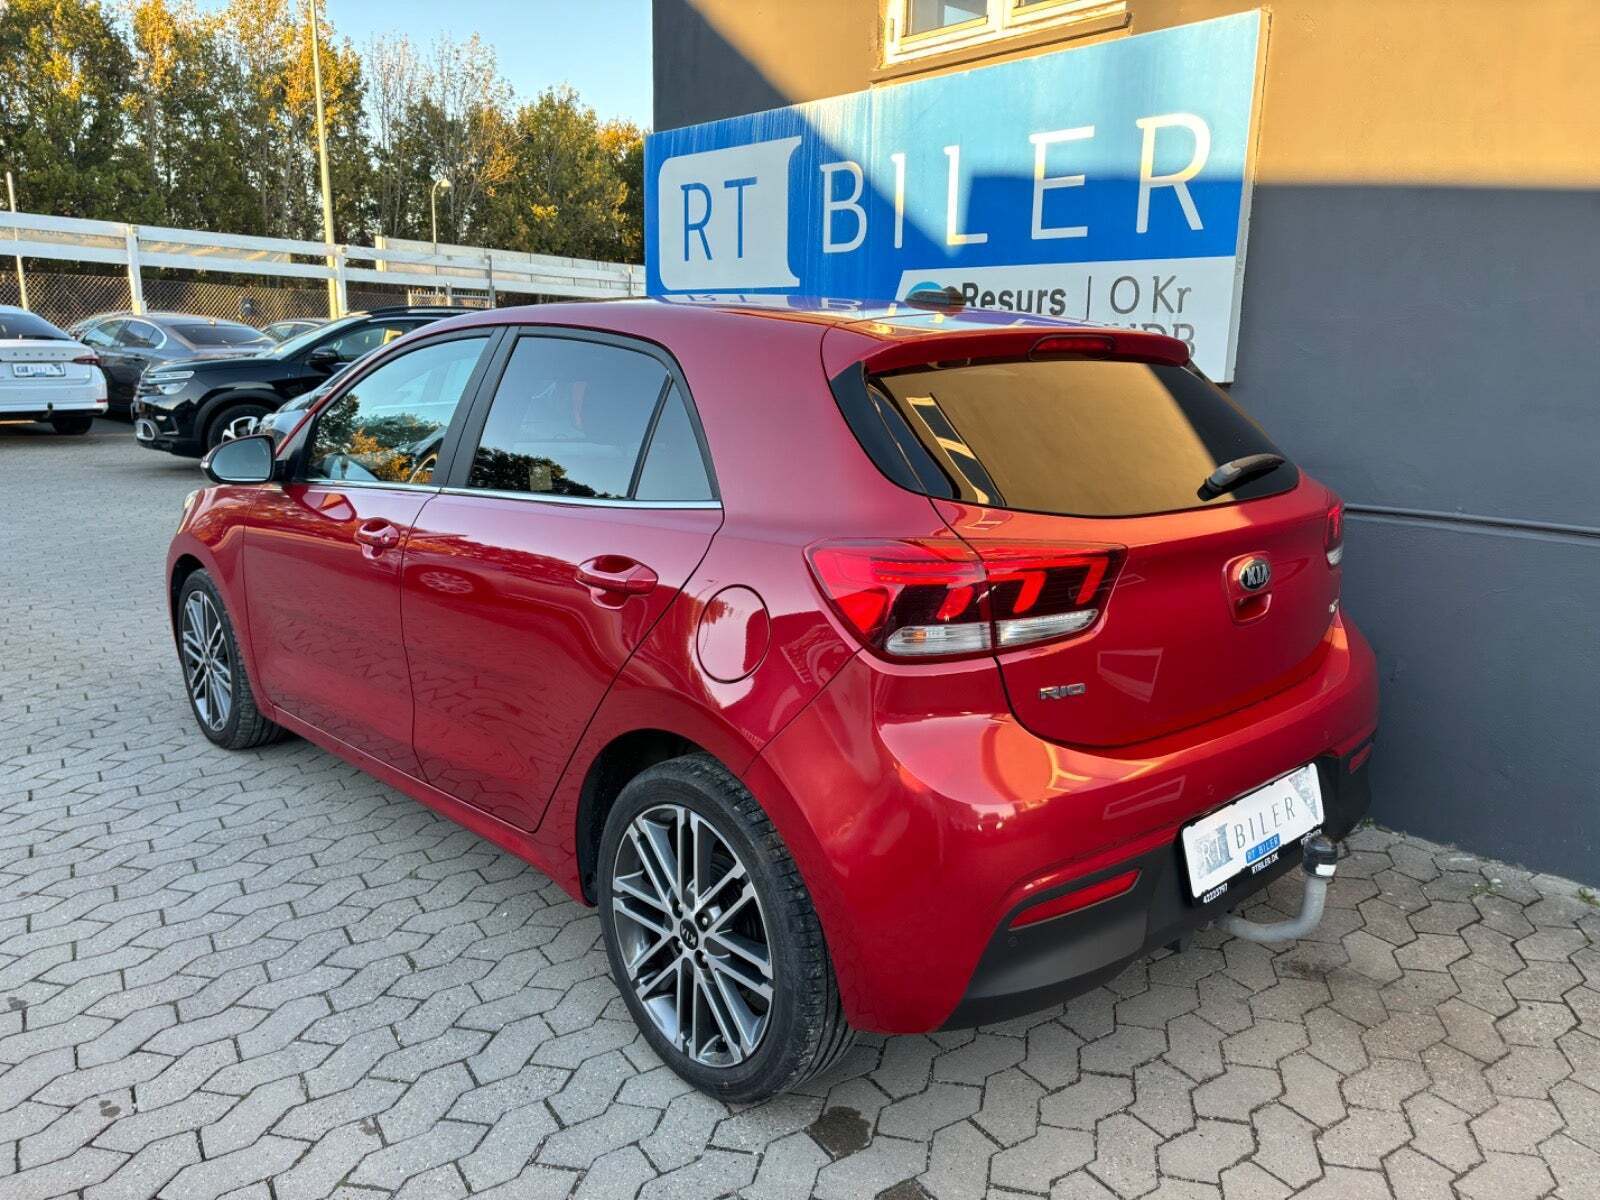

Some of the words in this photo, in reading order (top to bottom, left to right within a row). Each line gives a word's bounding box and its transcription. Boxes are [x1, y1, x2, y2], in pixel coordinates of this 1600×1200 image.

[680, 176, 759, 262] RT
[819, 112, 1212, 254] BILER
[962, 282, 1066, 316] Resurs
[1152, 275, 1192, 314] Kr
[1247, 564, 1269, 586] KIA
[1040, 683, 1085, 700] RIO
[1234, 796, 1296, 849] BILER
[1258, 836, 1279, 855] BILER
